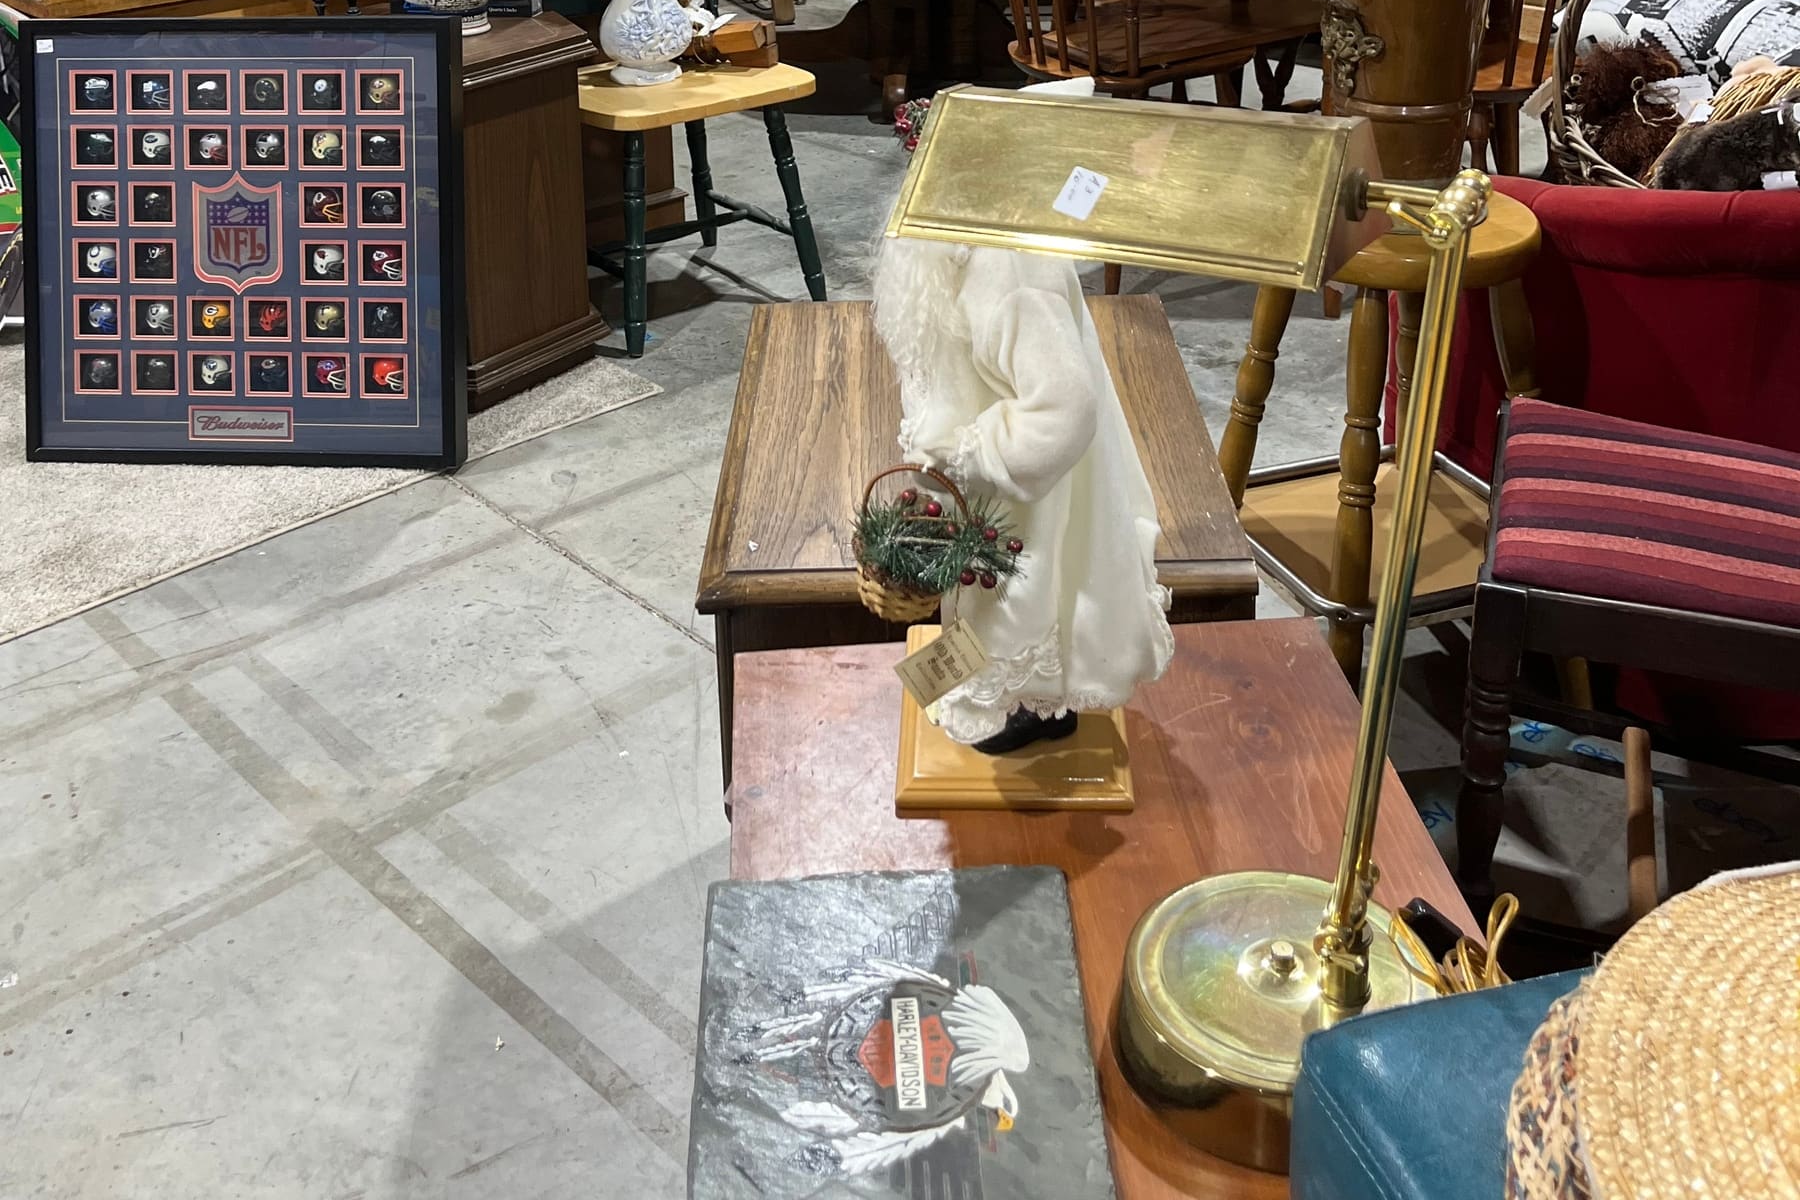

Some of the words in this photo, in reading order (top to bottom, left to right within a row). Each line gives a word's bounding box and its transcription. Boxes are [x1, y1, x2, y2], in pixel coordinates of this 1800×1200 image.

[212, 227, 266, 265] NFL
[196, 415, 285, 431] Budweiser
[897, 998, 921, 1107] HARLEY-DAVIDSON
